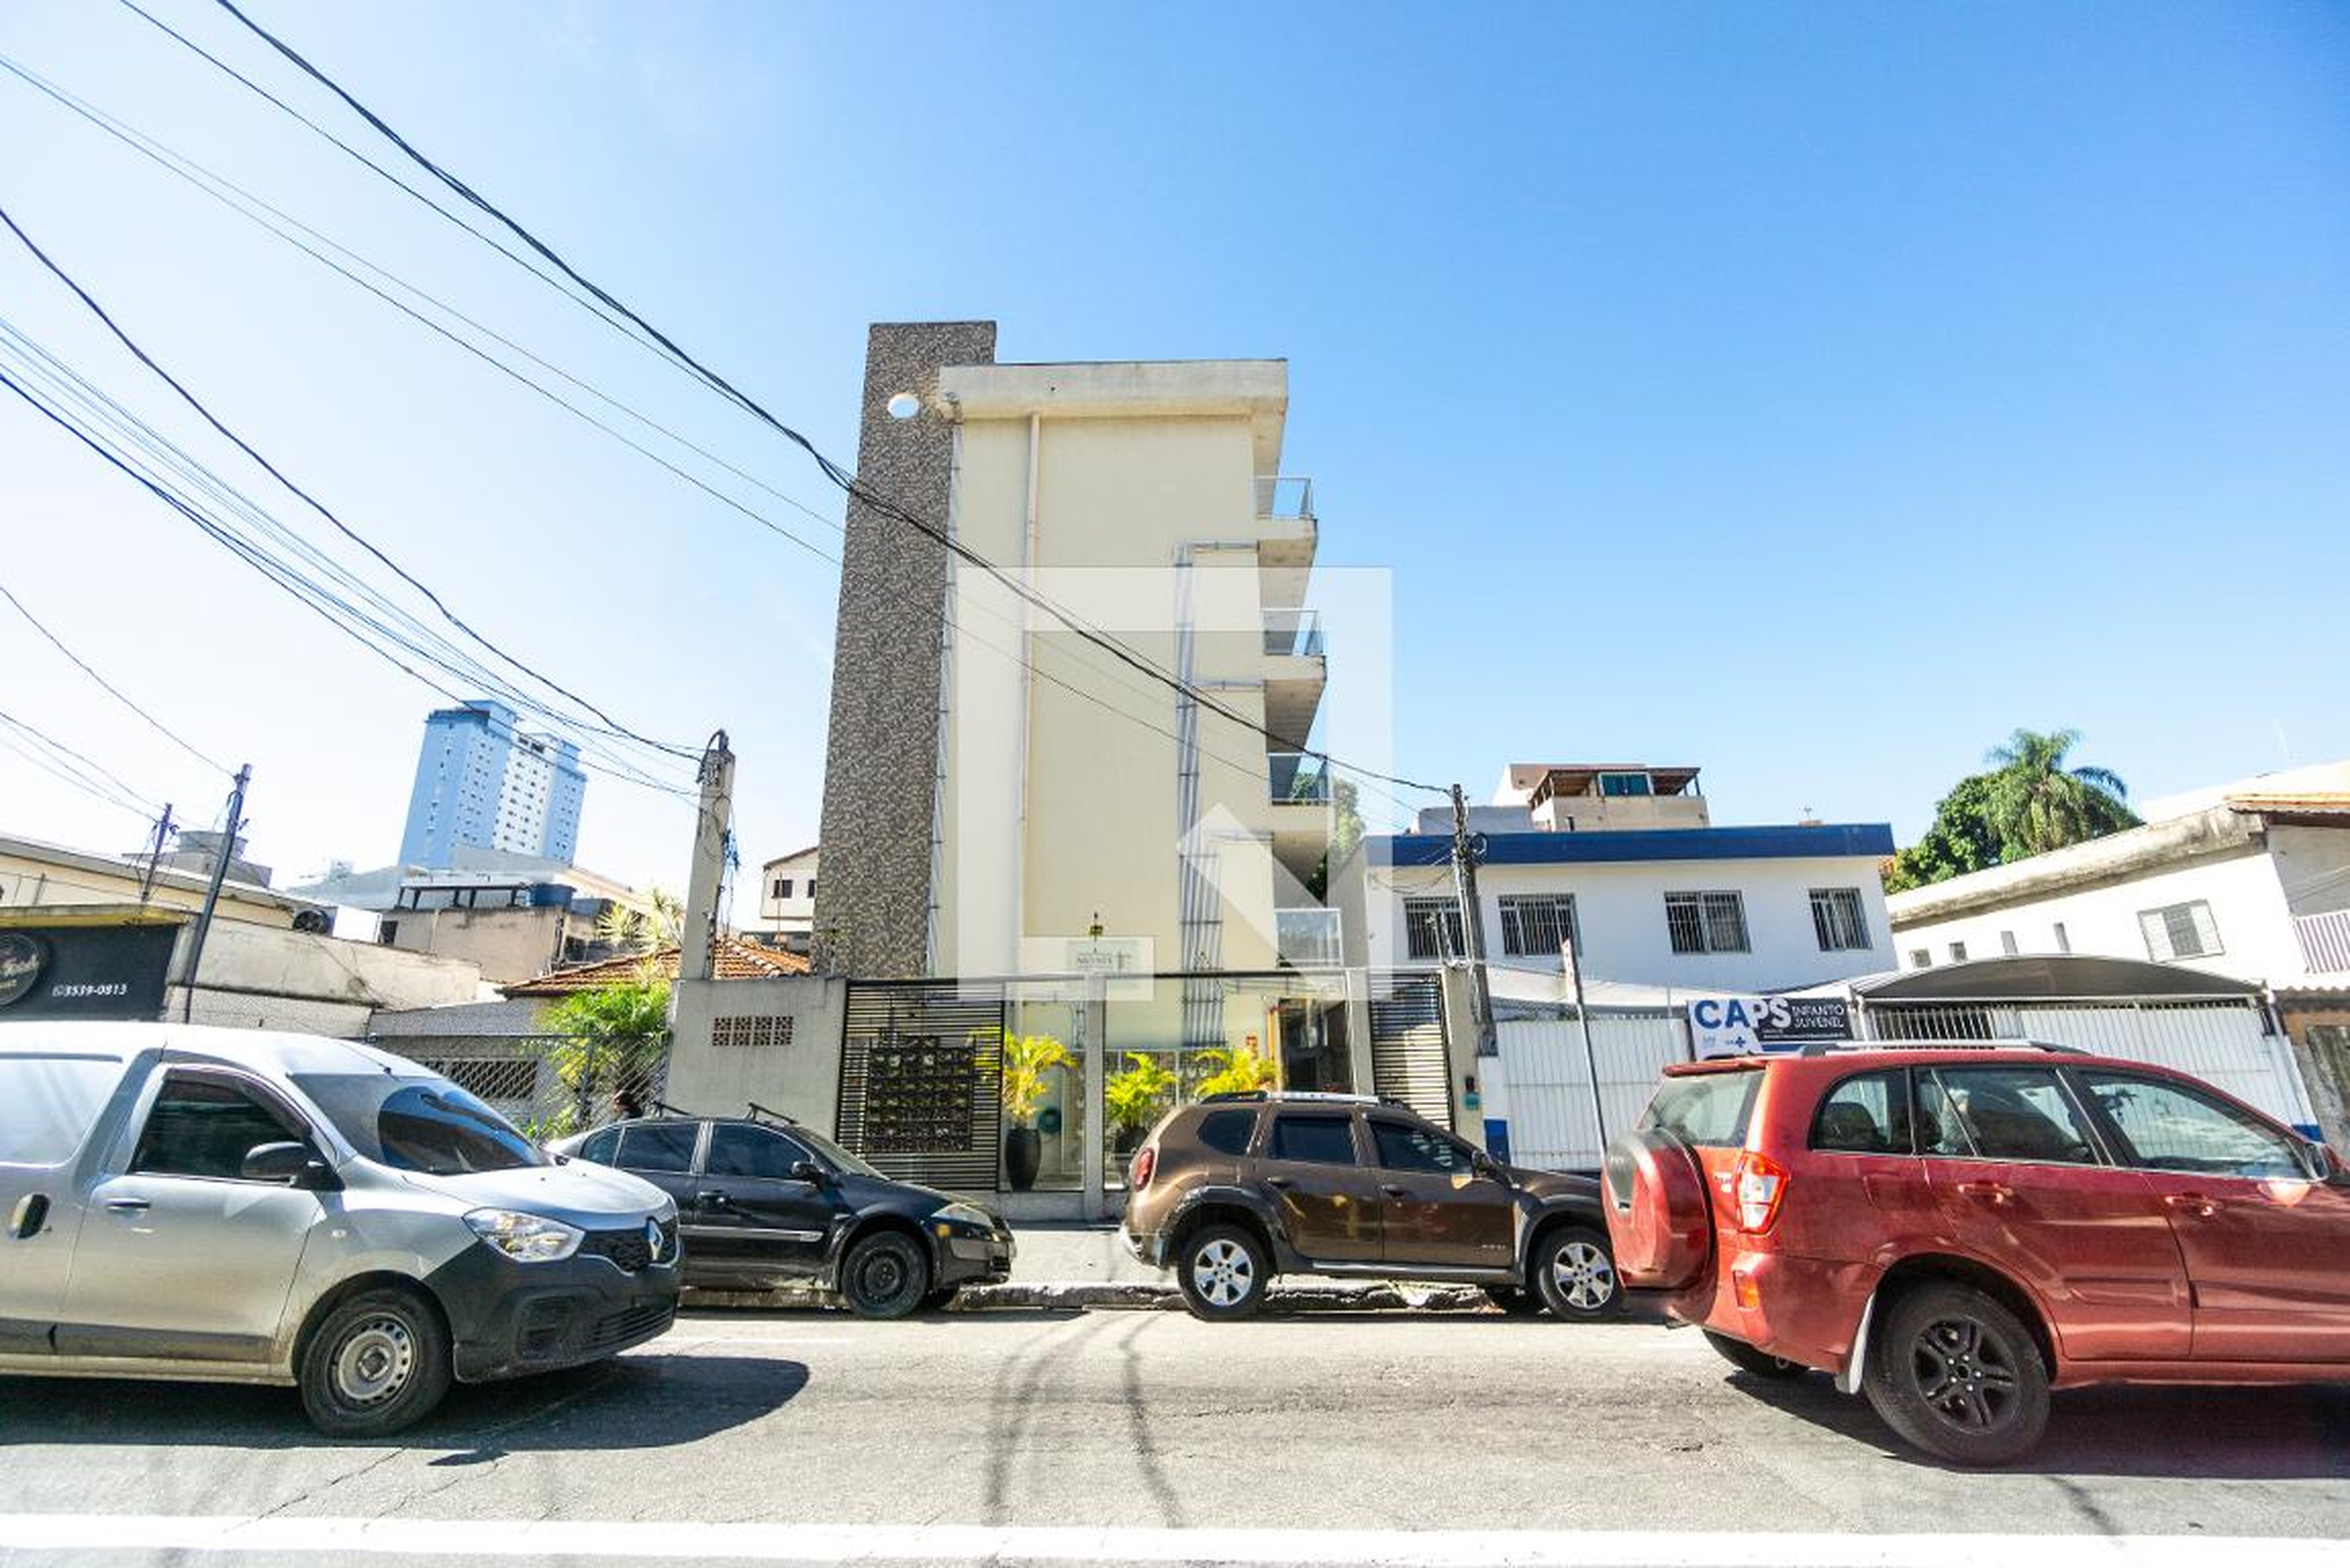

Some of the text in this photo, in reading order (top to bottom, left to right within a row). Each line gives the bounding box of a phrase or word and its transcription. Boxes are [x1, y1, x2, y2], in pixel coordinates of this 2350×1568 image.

[1694, 996, 1792, 1030] CAPS
[1791, 1004, 1845, 1017] INFANTO
[1794, 1017, 1845, 1028] JUVENIL
